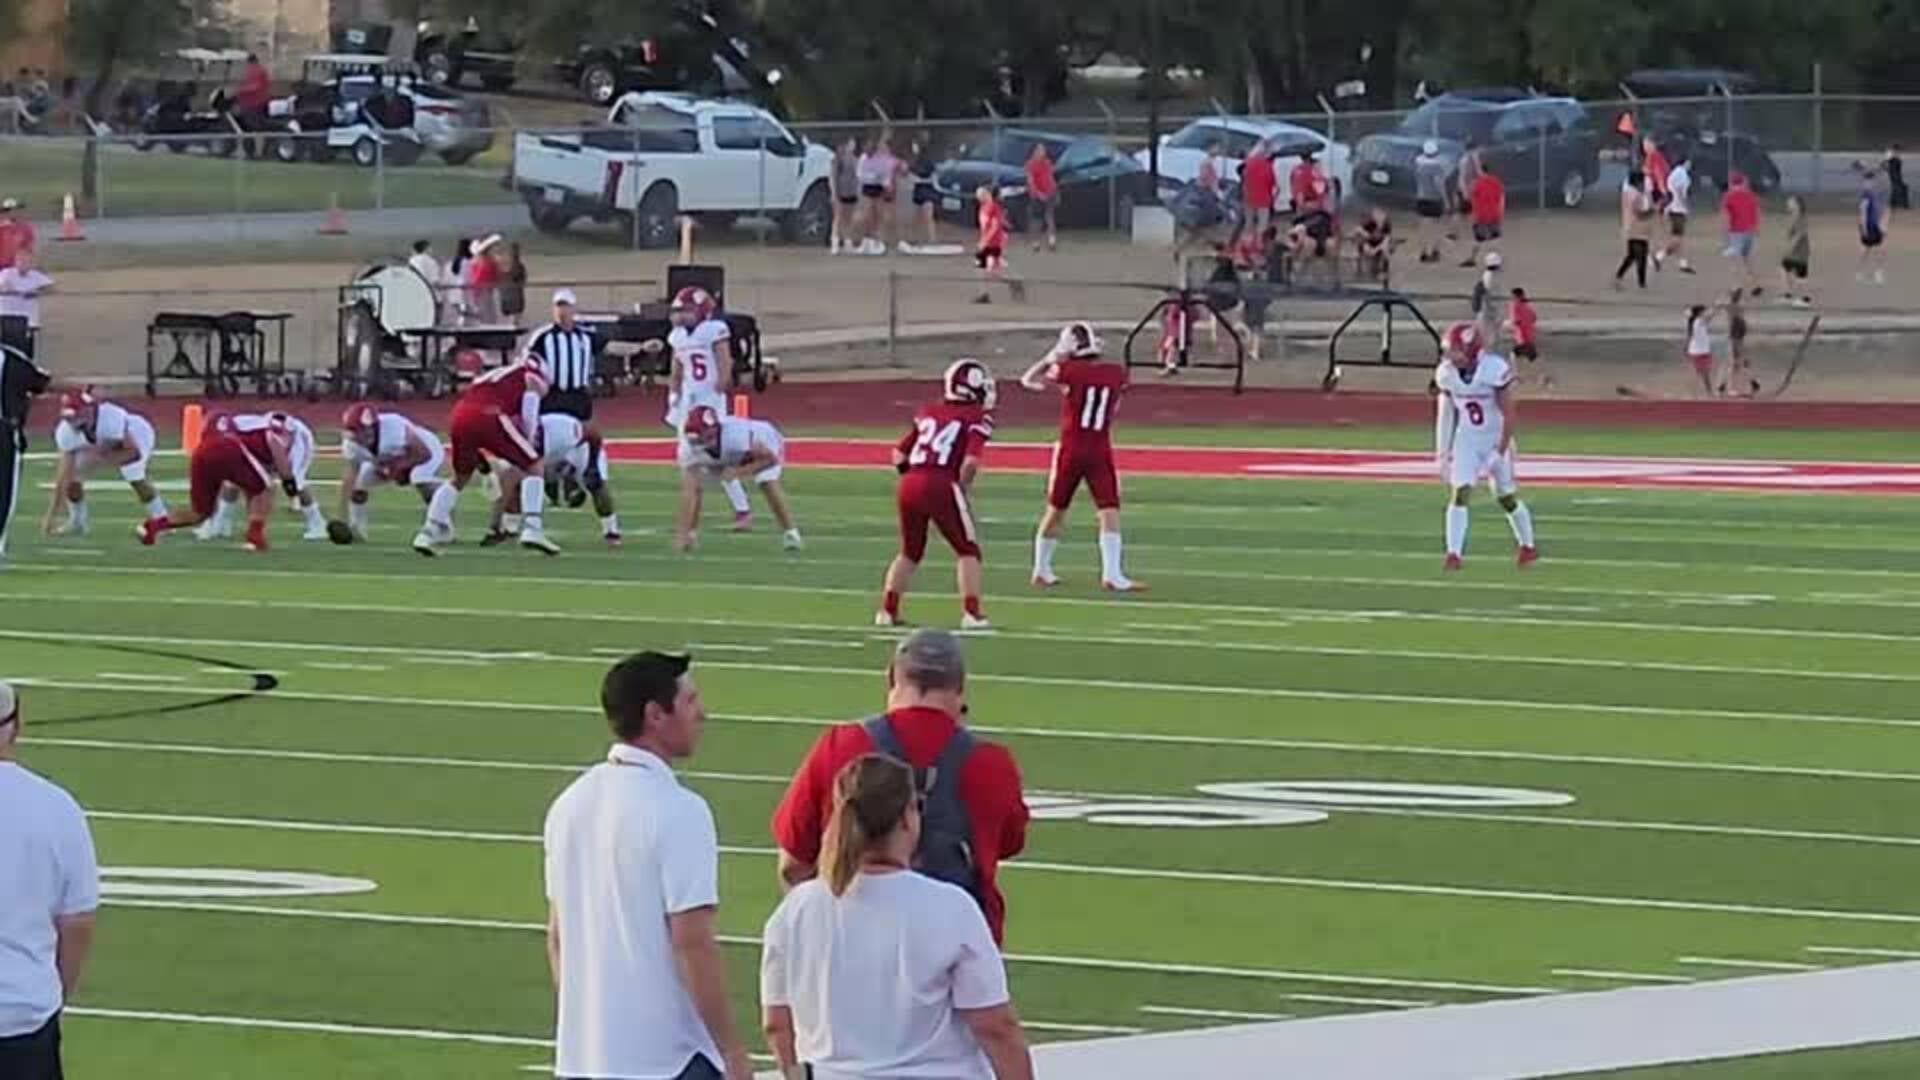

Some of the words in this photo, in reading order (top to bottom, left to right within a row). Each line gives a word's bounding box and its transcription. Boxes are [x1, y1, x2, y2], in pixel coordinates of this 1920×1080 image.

[690, 353, 707, 382] 6
[1081, 386, 1110, 431] 11
[909, 416, 962, 465] 24
